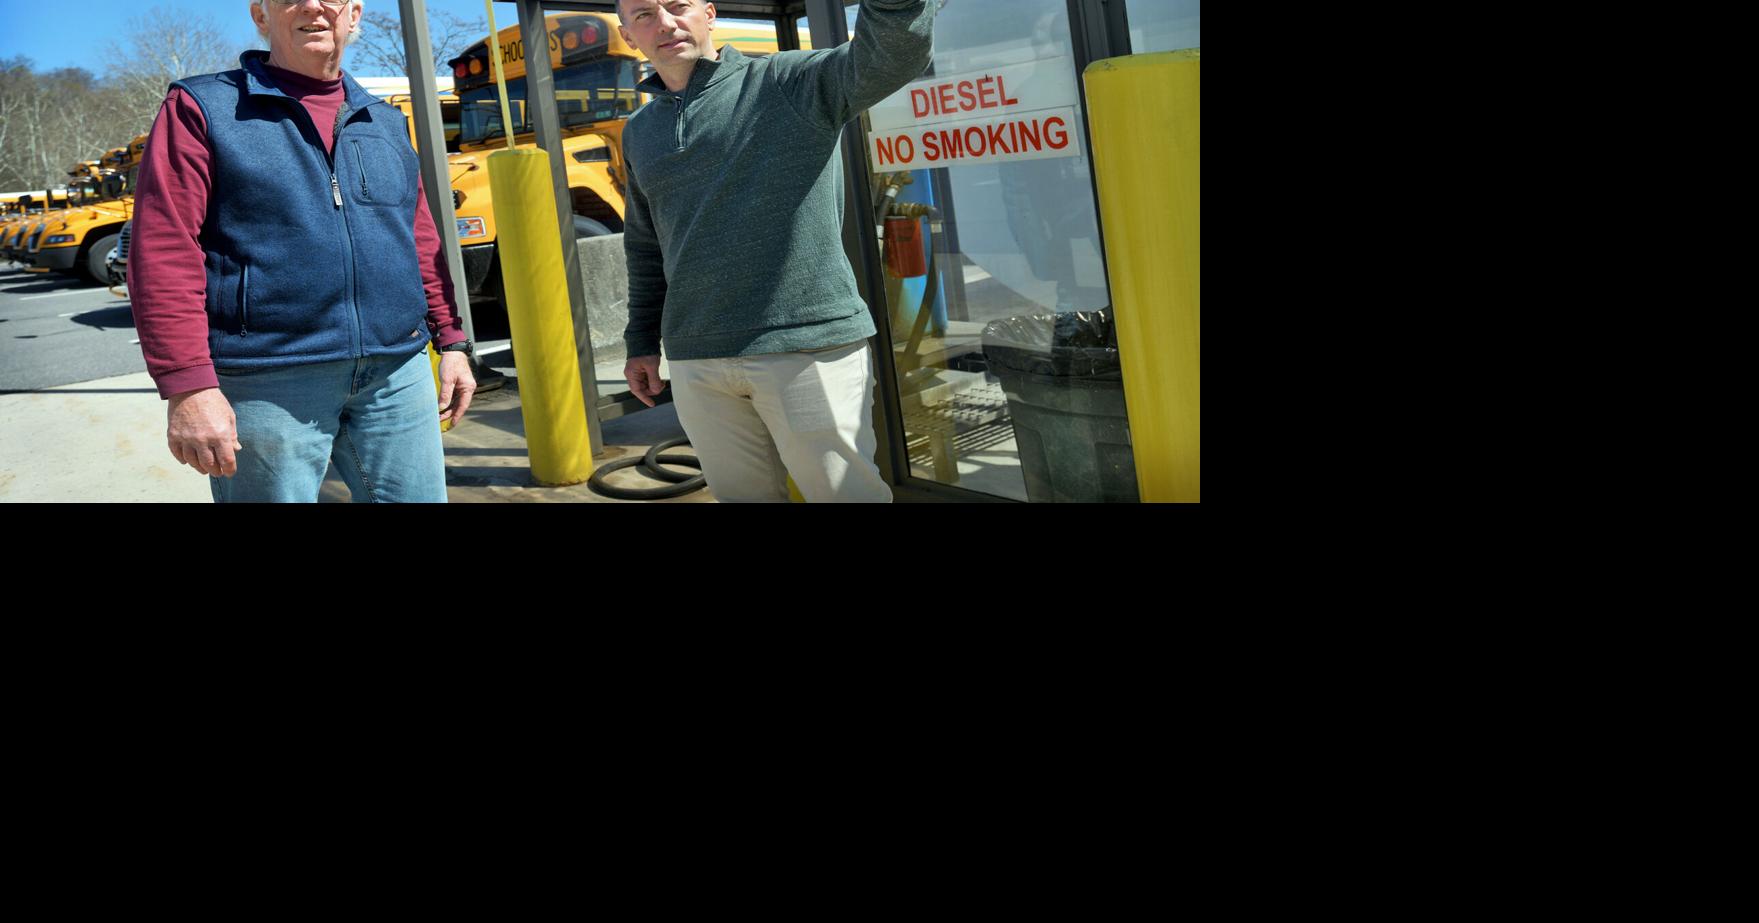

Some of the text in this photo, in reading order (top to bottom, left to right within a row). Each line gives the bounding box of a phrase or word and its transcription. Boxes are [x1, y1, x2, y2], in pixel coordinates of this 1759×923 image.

[491, 39, 525, 66] CHOO
[911, 76, 1018, 118] DIESEL
[876, 117, 1068, 165] NO SMOKING
